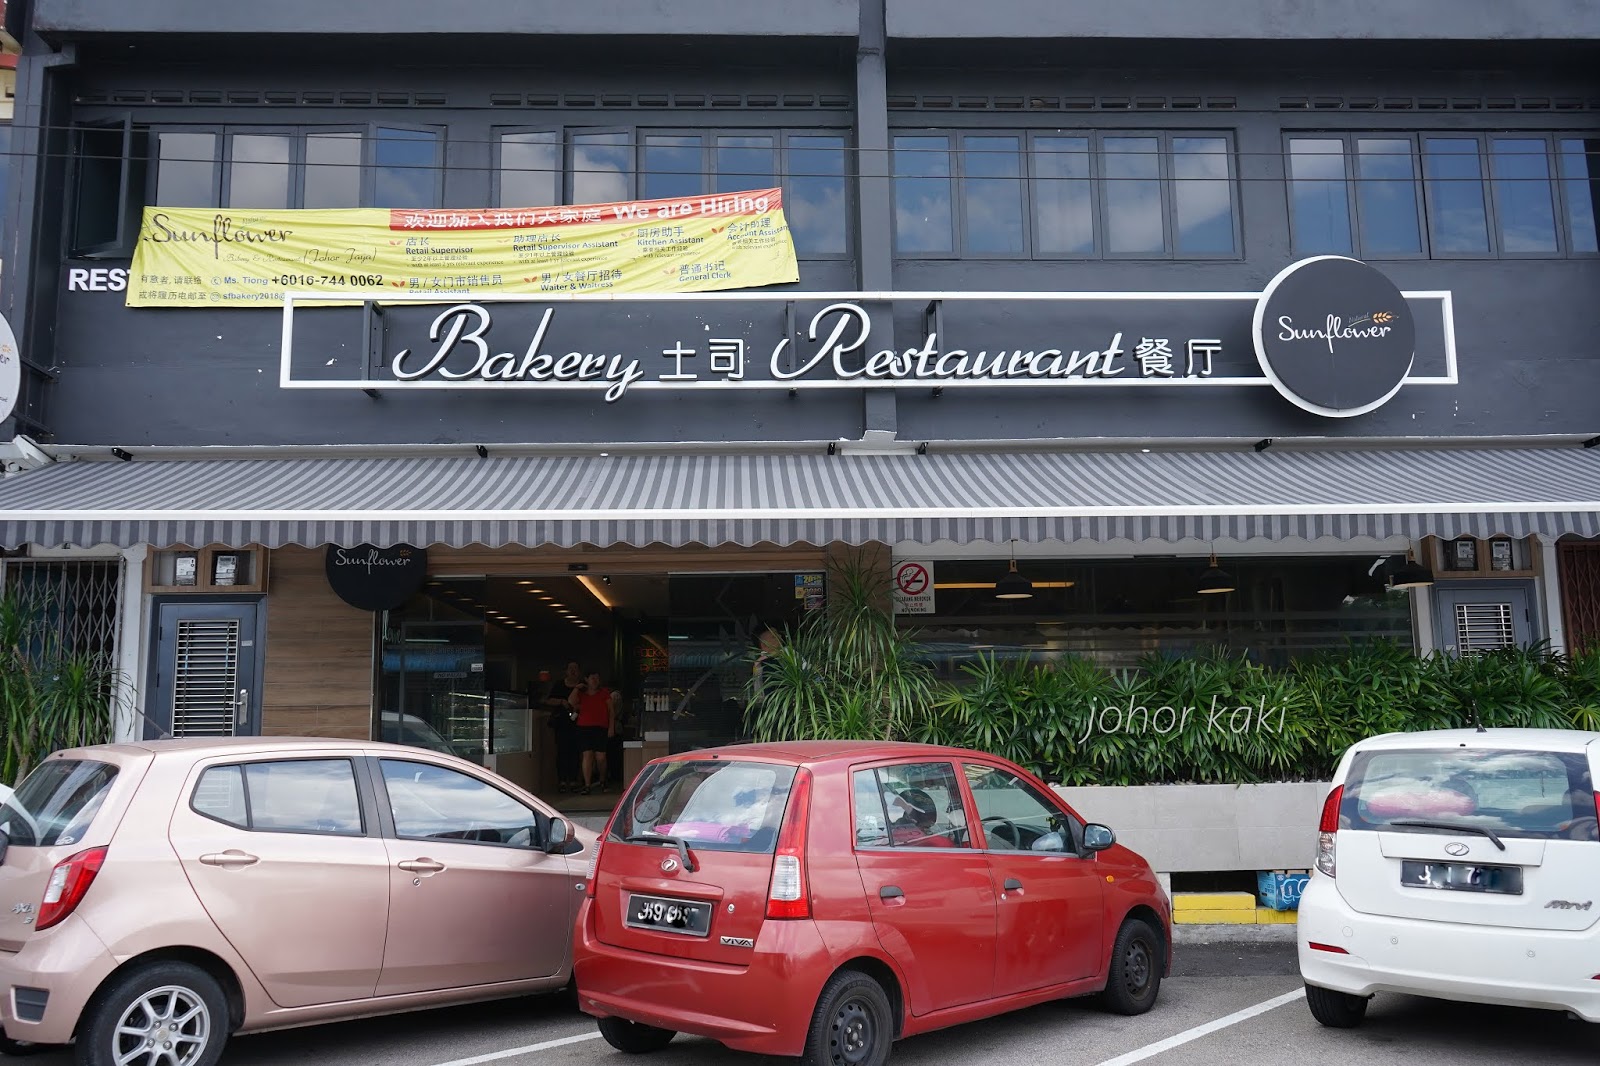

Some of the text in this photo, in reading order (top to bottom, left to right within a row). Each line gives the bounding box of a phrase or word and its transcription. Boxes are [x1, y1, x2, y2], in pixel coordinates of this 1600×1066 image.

[404, 196, 768, 228] 欢迎加入我们大家庭 We are Hiring
[149, 214, 292, 259] Sunflower
[638, 226, 684, 238] 厨房助手
[759, 225, 789, 236] Assistan
[406, 237, 429, 246] 店长
[514, 234, 560, 242] 助理店长
[431, 247, 473, 255] Supervisor
[538, 243, 579, 251] Supervisor
[680, 260, 725, 275] 普通书记
[68, 268, 130, 291] RES
[243, 277, 268, 285] Tiong
[272, 275, 346, 286] +6016-744
[351, 274, 383, 286] 0062
[680, 273, 709, 281] General
[1278, 314, 1392, 353] Sunflower
[392, 303, 1222, 402] Bakery 土司 Restaurant 餐厅
[335, 549, 410, 575] Sunflower
[721, 938, 752, 946] VIVA
